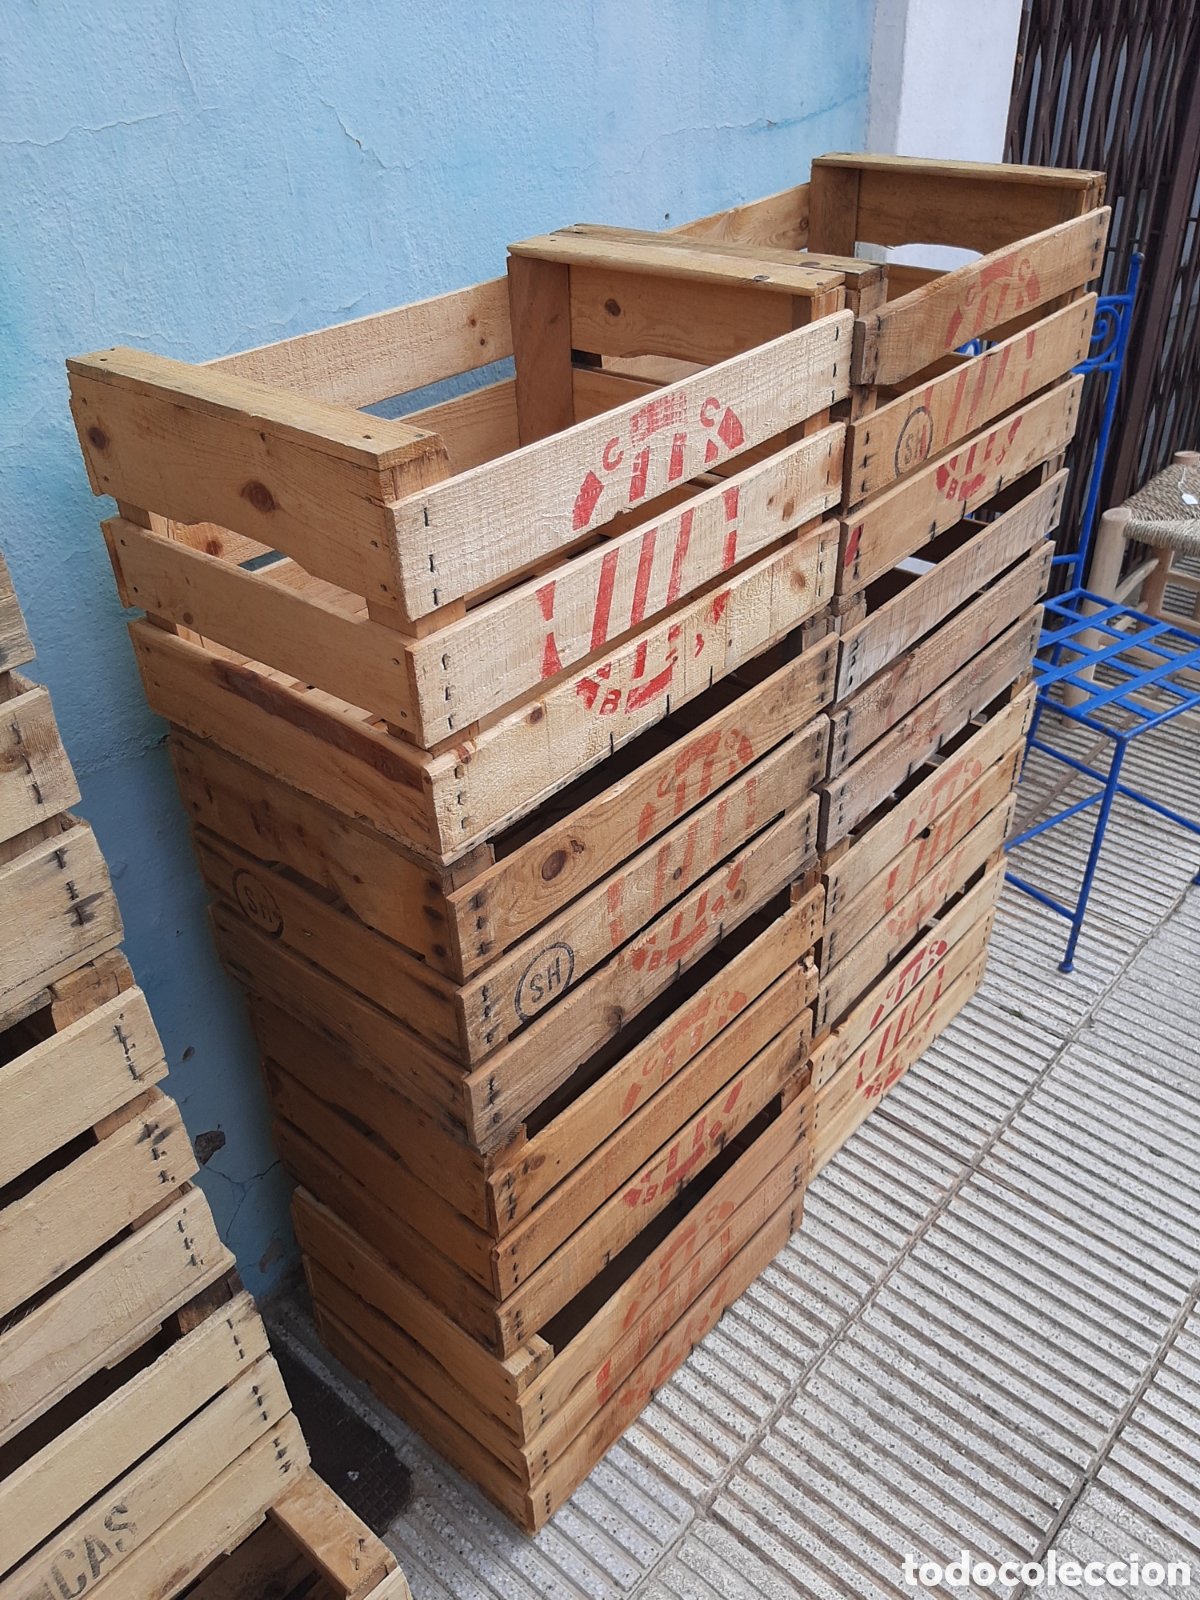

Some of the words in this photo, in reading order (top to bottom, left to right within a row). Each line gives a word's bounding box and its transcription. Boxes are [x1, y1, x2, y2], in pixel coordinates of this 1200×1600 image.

[602, 437, 625, 471] C
[700, 397, 721, 428] C
[599, 688, 622, 715] B
[529, 956, 561, 1004] SH
